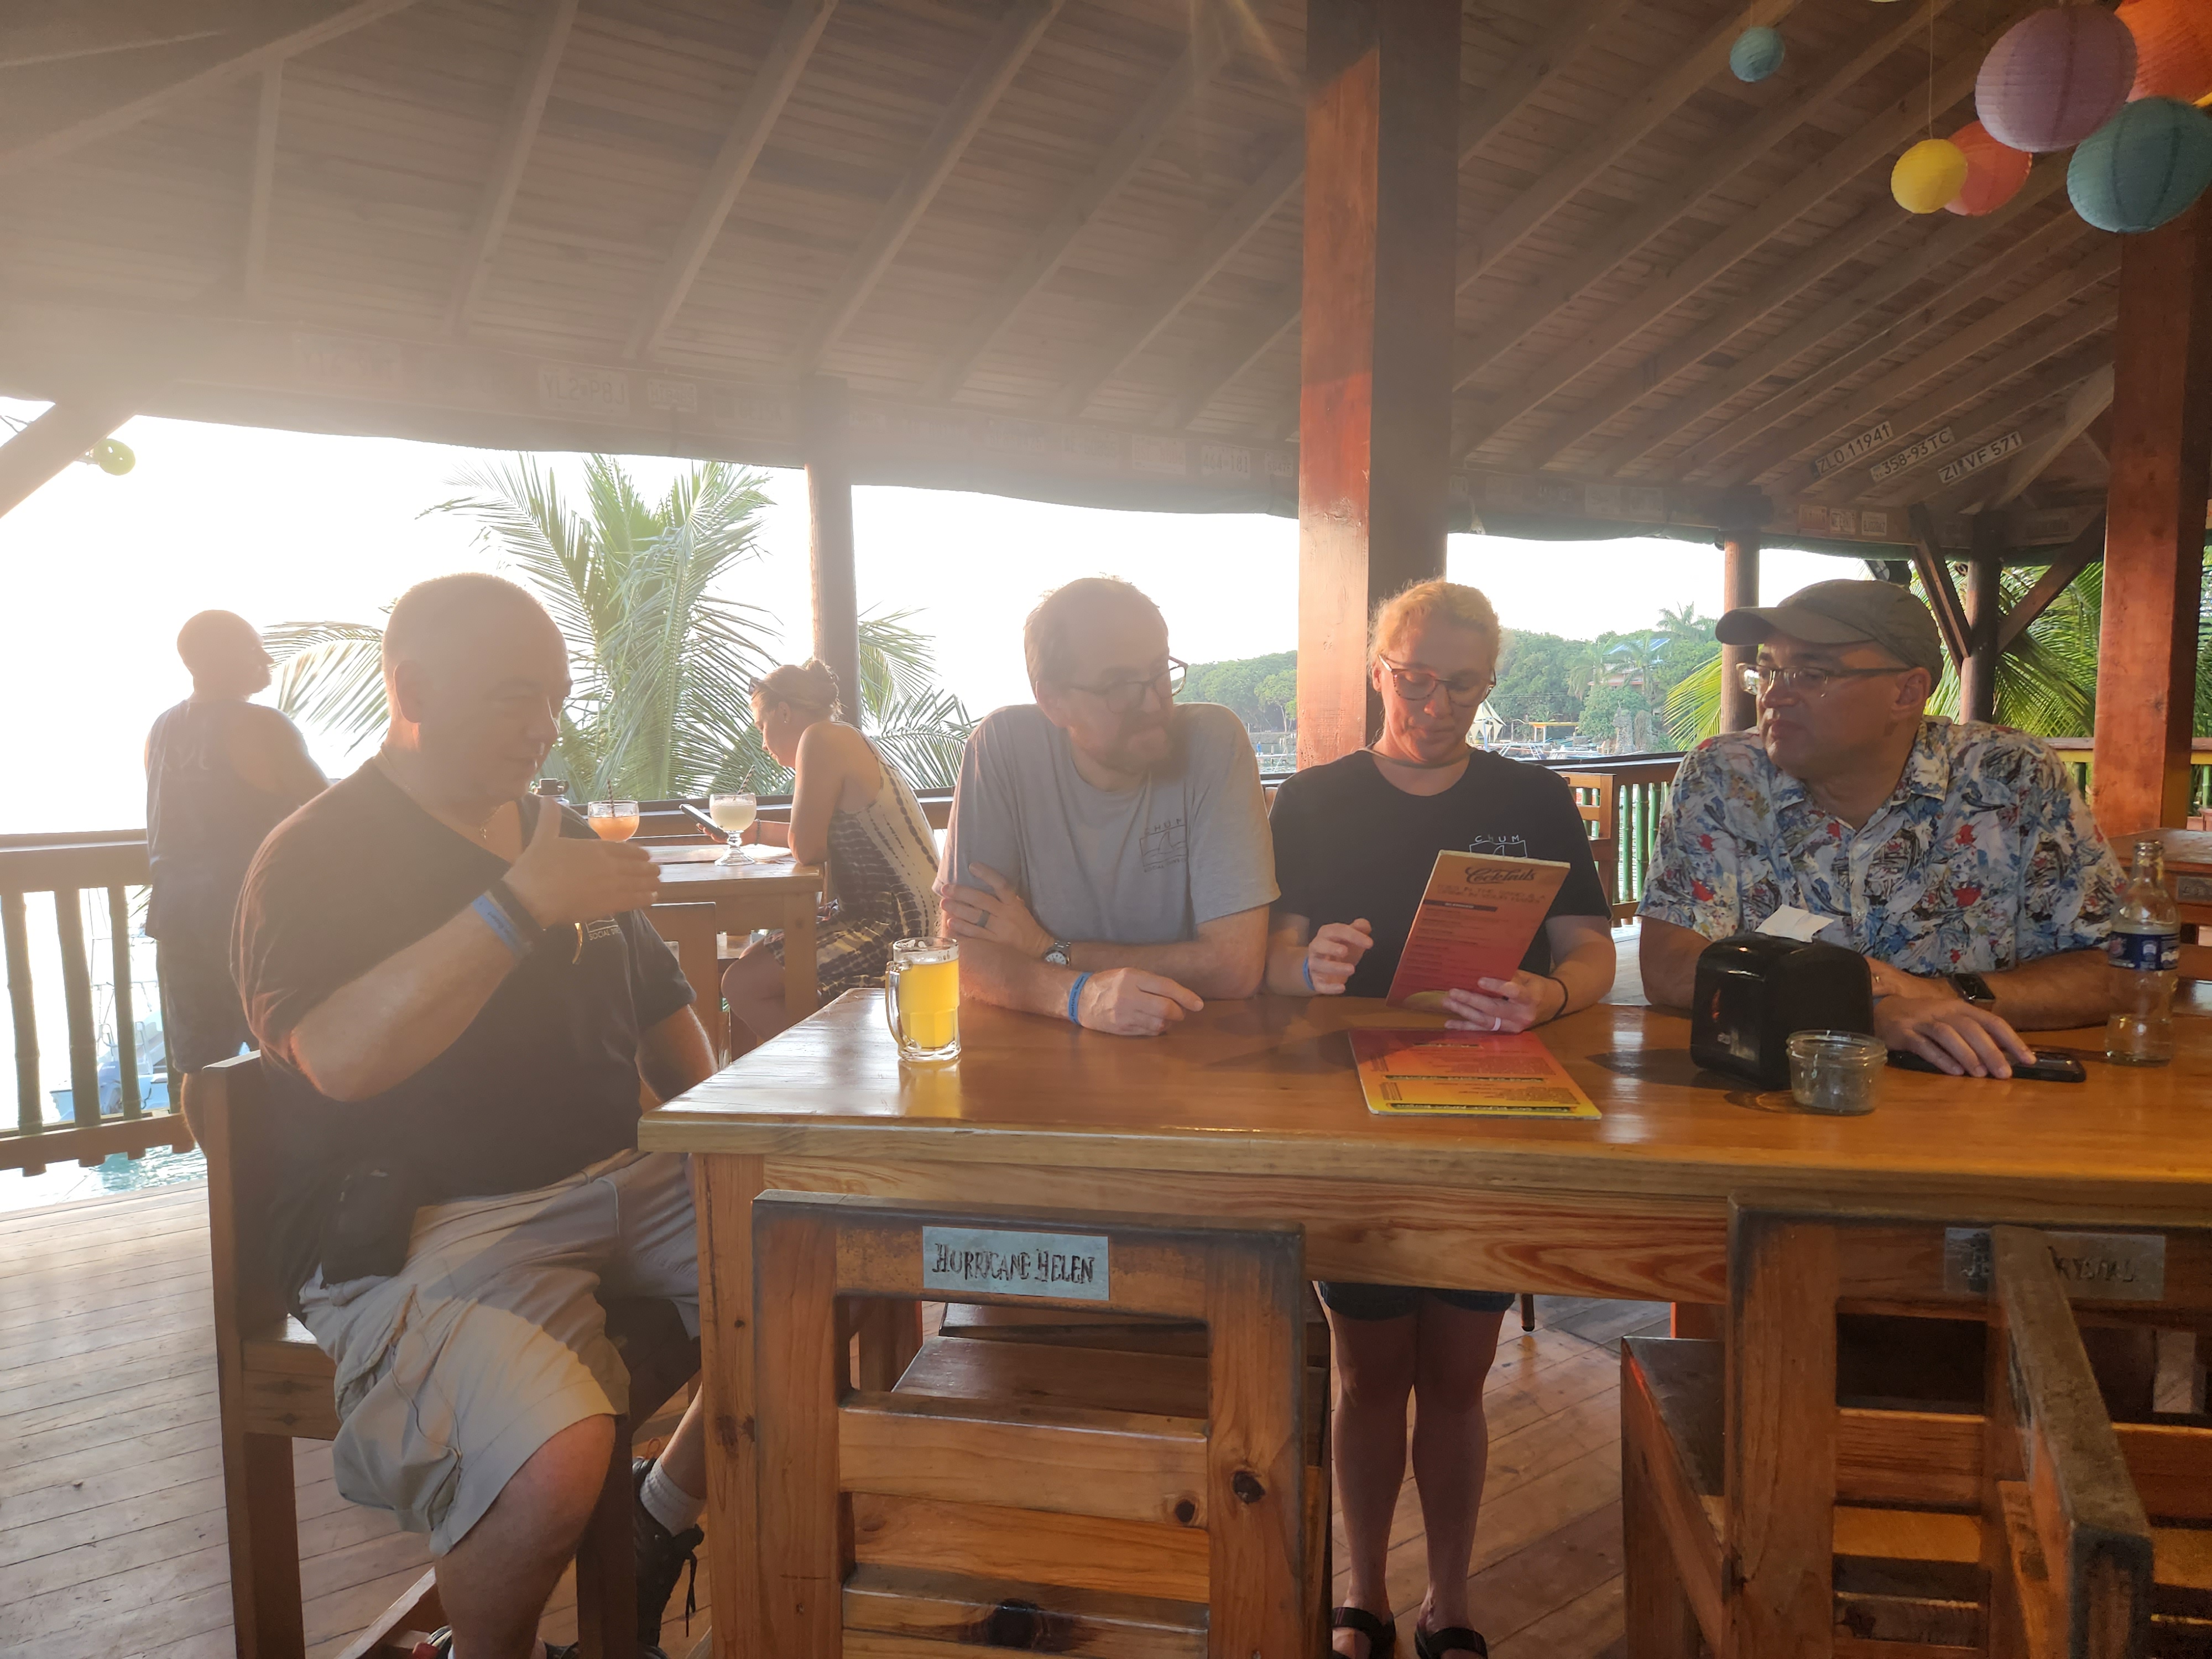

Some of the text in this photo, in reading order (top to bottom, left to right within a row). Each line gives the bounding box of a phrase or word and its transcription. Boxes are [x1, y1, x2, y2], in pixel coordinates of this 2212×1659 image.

[1848, 424, 1890, 456] 11941
[1965, 449, 1986, 468] VF
[1991, 433, 2019, 456] 571
[1475, 834, 1520, 843] CHUM
[589, 929, 610, 941] SOCIAL
[932, 1243, 1095, 1284] HURRICANE HELEN
